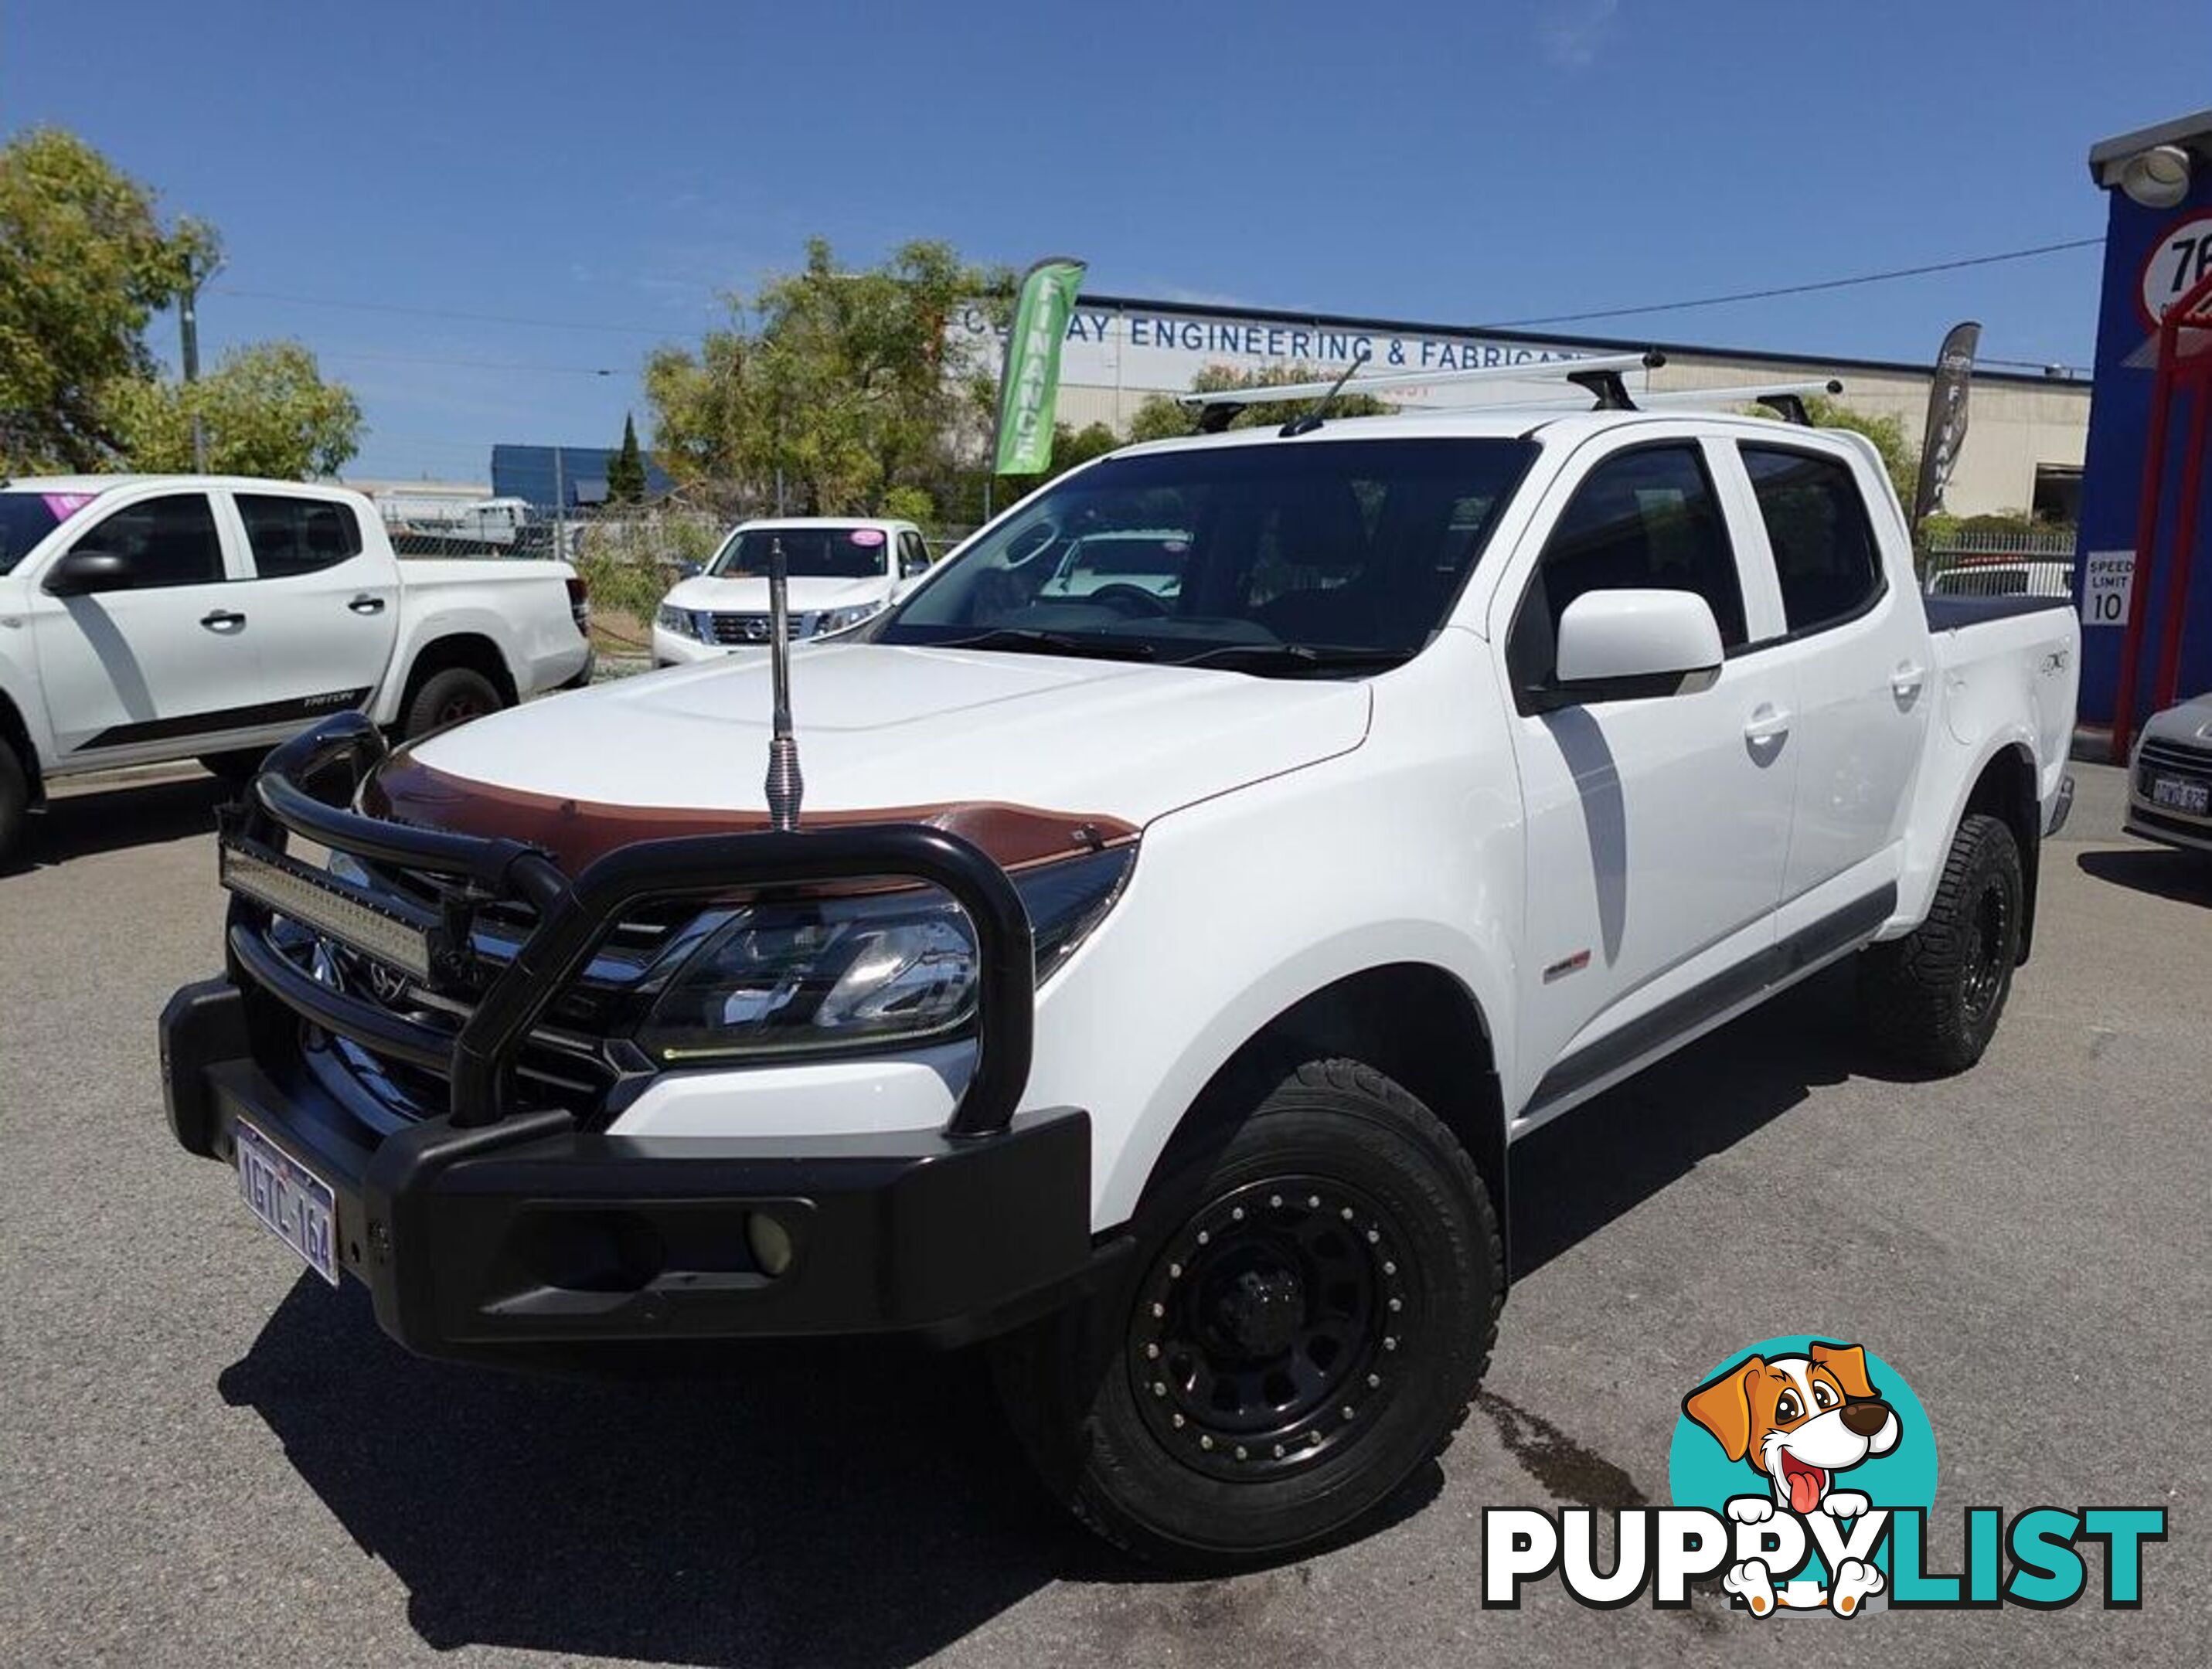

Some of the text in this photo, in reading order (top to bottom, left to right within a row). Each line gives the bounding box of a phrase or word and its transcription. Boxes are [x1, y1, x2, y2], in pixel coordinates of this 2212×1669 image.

[1132, 318, 1372, 362] ENGINEERING
[1388, 339, 1405, 366] &
[1013, 276, 1060, 462] FINANCE
[2090, 561, 2135, 573] SPEED
[2092, 576, 2127, 588] LIMIT
[2095, 593, 2121, 620] 10
